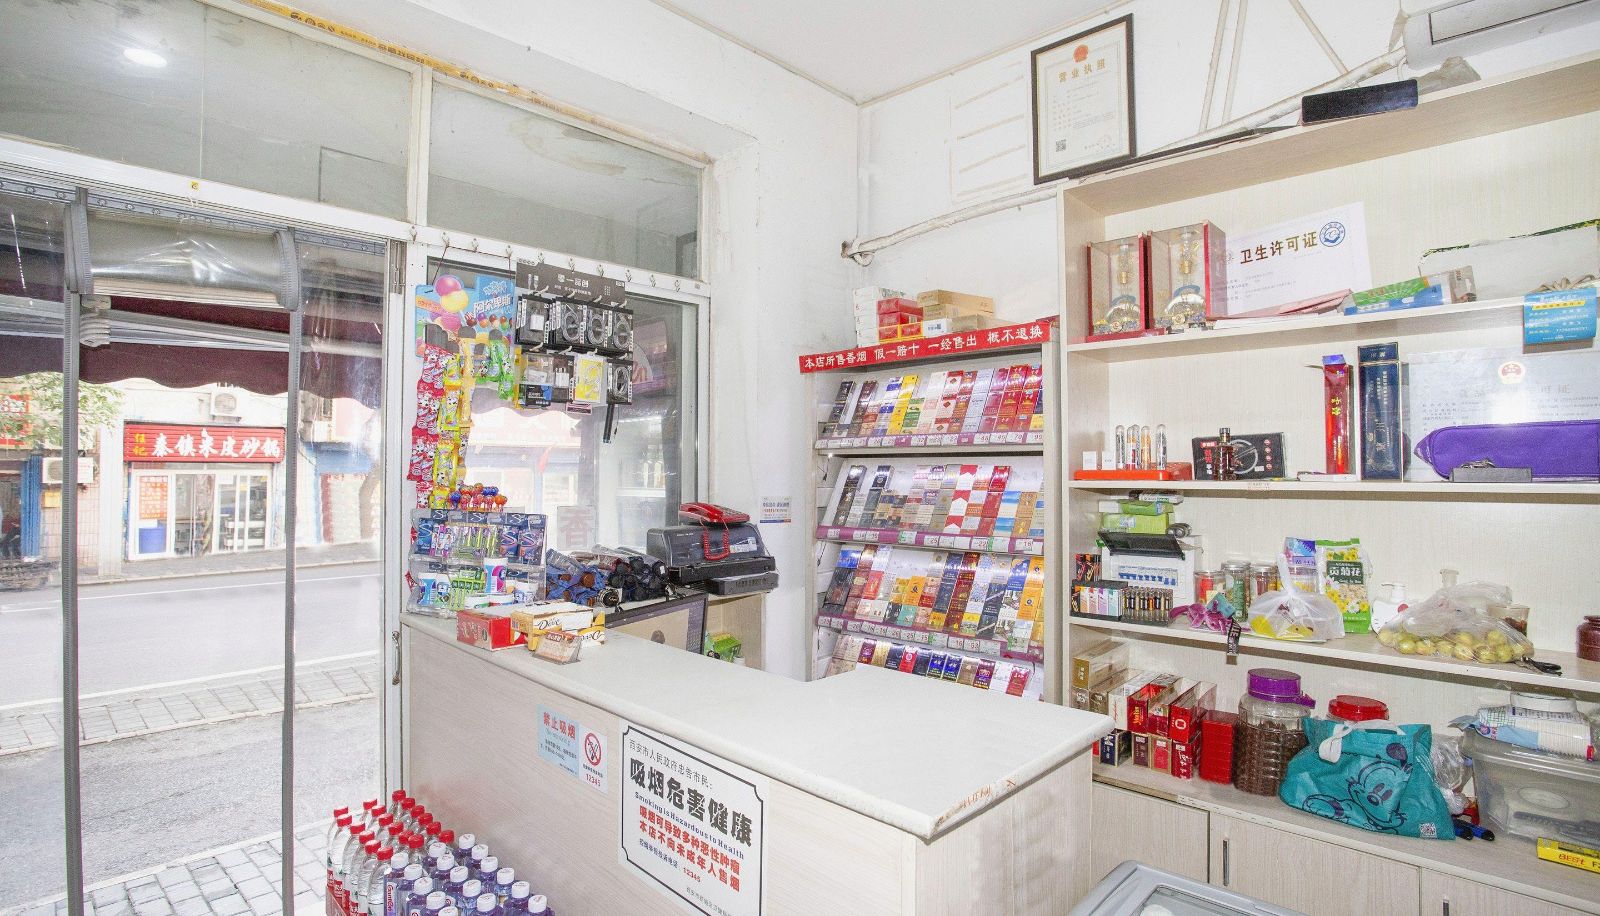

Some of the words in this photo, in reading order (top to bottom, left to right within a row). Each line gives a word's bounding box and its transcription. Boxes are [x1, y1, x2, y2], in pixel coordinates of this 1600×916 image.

[1058, 57, 1107, 83] 营业执照
[1240, 231, 1319, 264] 卫生许可证
[804, 350, 868, 370] 本店所售香烟
[873, 342, 920, 361] 假一赔十
[927, 334, 978, 350] 一经售出
[987, 325, 1043, 344] 概不退换
[543, 711, 576, 741] 禁止吸烟
[586, 773, 602, 787] 12345
[630, 757, 753, 847] 吸烟危害健康
[635, 791, 663, 816] Smoking
[717, 837, 745, 860] Health
[639, 805, 740, 876] 吸烟可导致多种恶性肿瘤
[639, 820, 740, 893] 本店不向未成年人售烟
